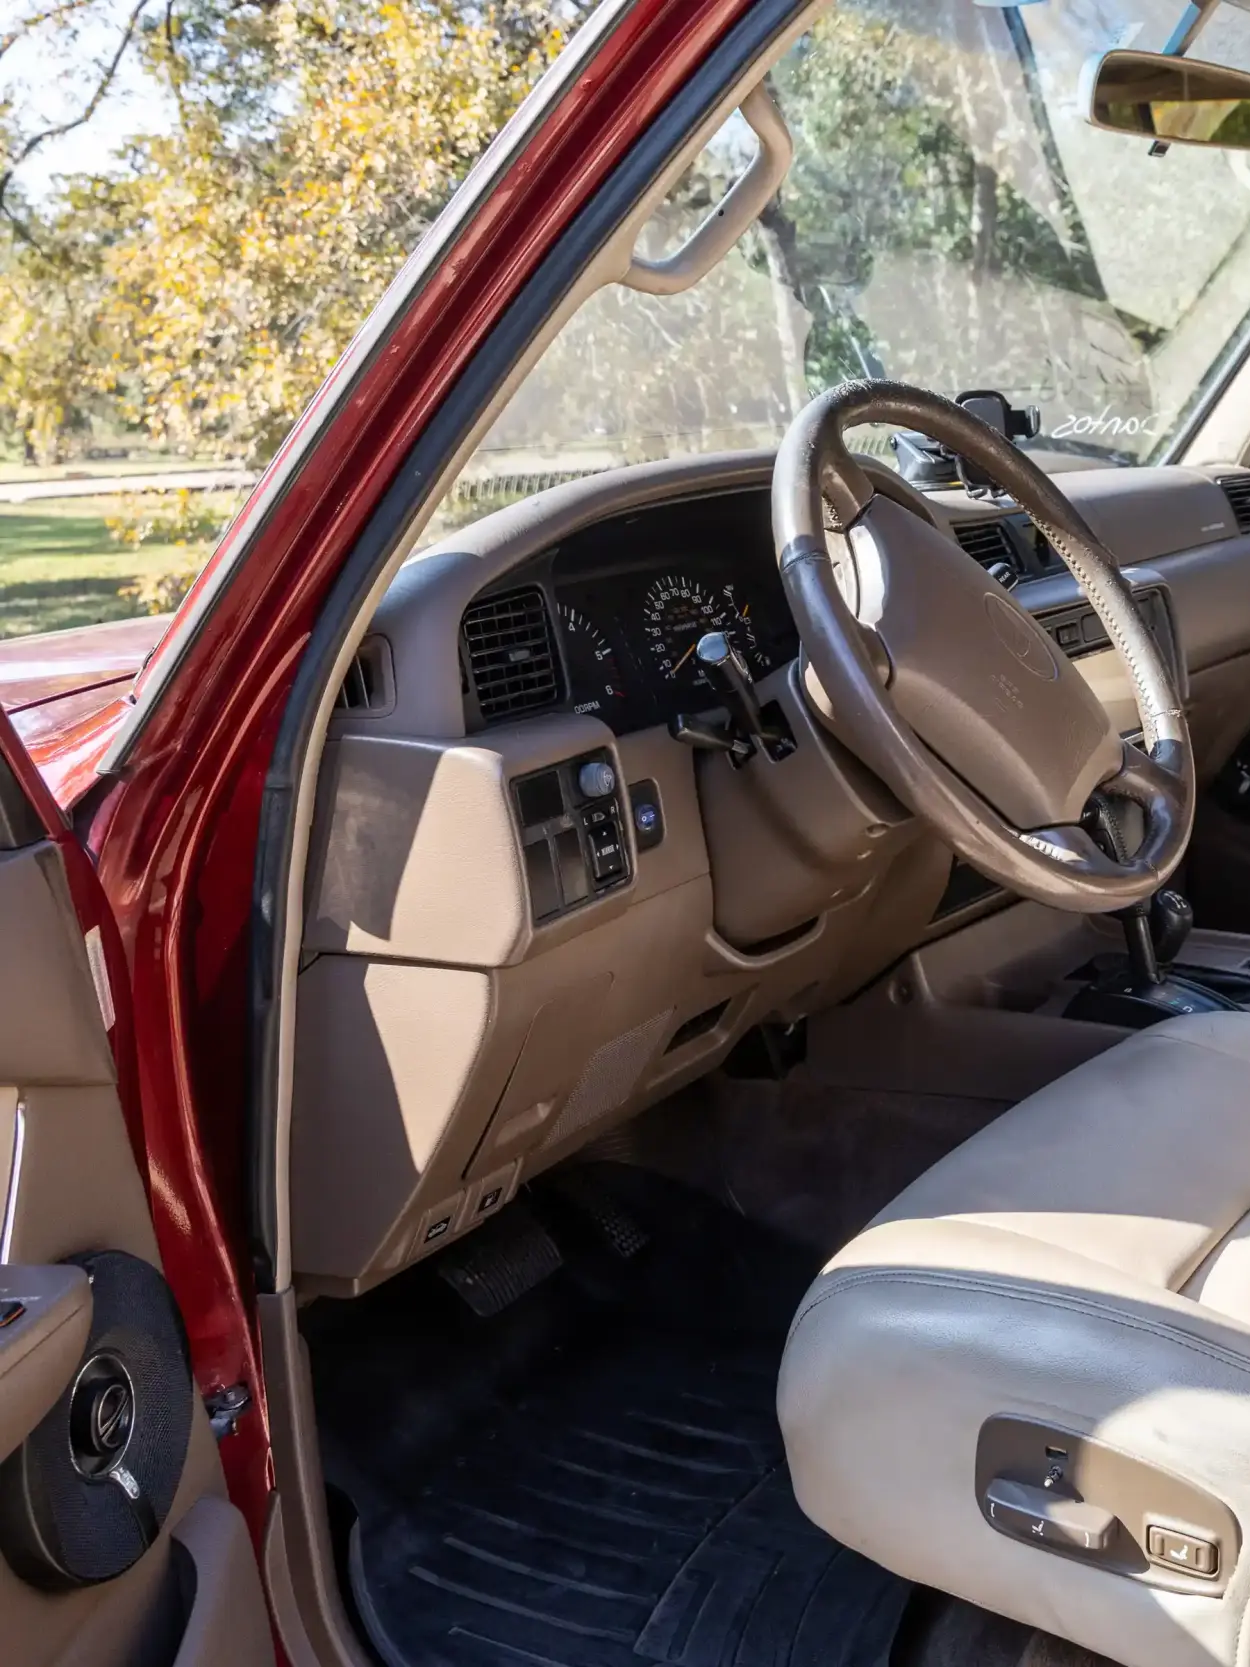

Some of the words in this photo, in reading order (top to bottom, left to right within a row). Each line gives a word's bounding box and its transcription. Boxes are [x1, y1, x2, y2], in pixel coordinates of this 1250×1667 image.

[660, 591, 670, 601] 60
[669, 587, 680, 597] 70
[680, 588, 691, 598] 80
[691, 595, 702, 604] 90
[654, 600, 665, 610] 50
[701, 605, 714, 615] 100
[651, 612, 661, 621] 40
[710, 617, 723, 626] 110
[568, 622, 576, 632] 4
[650, 627, 662, 637] 30
[655, 643, 666, 653] 20
[594, 650, 604, 661] 5
[662, 659, 672, 668] 10
[604, 685, 614, 696] 6
